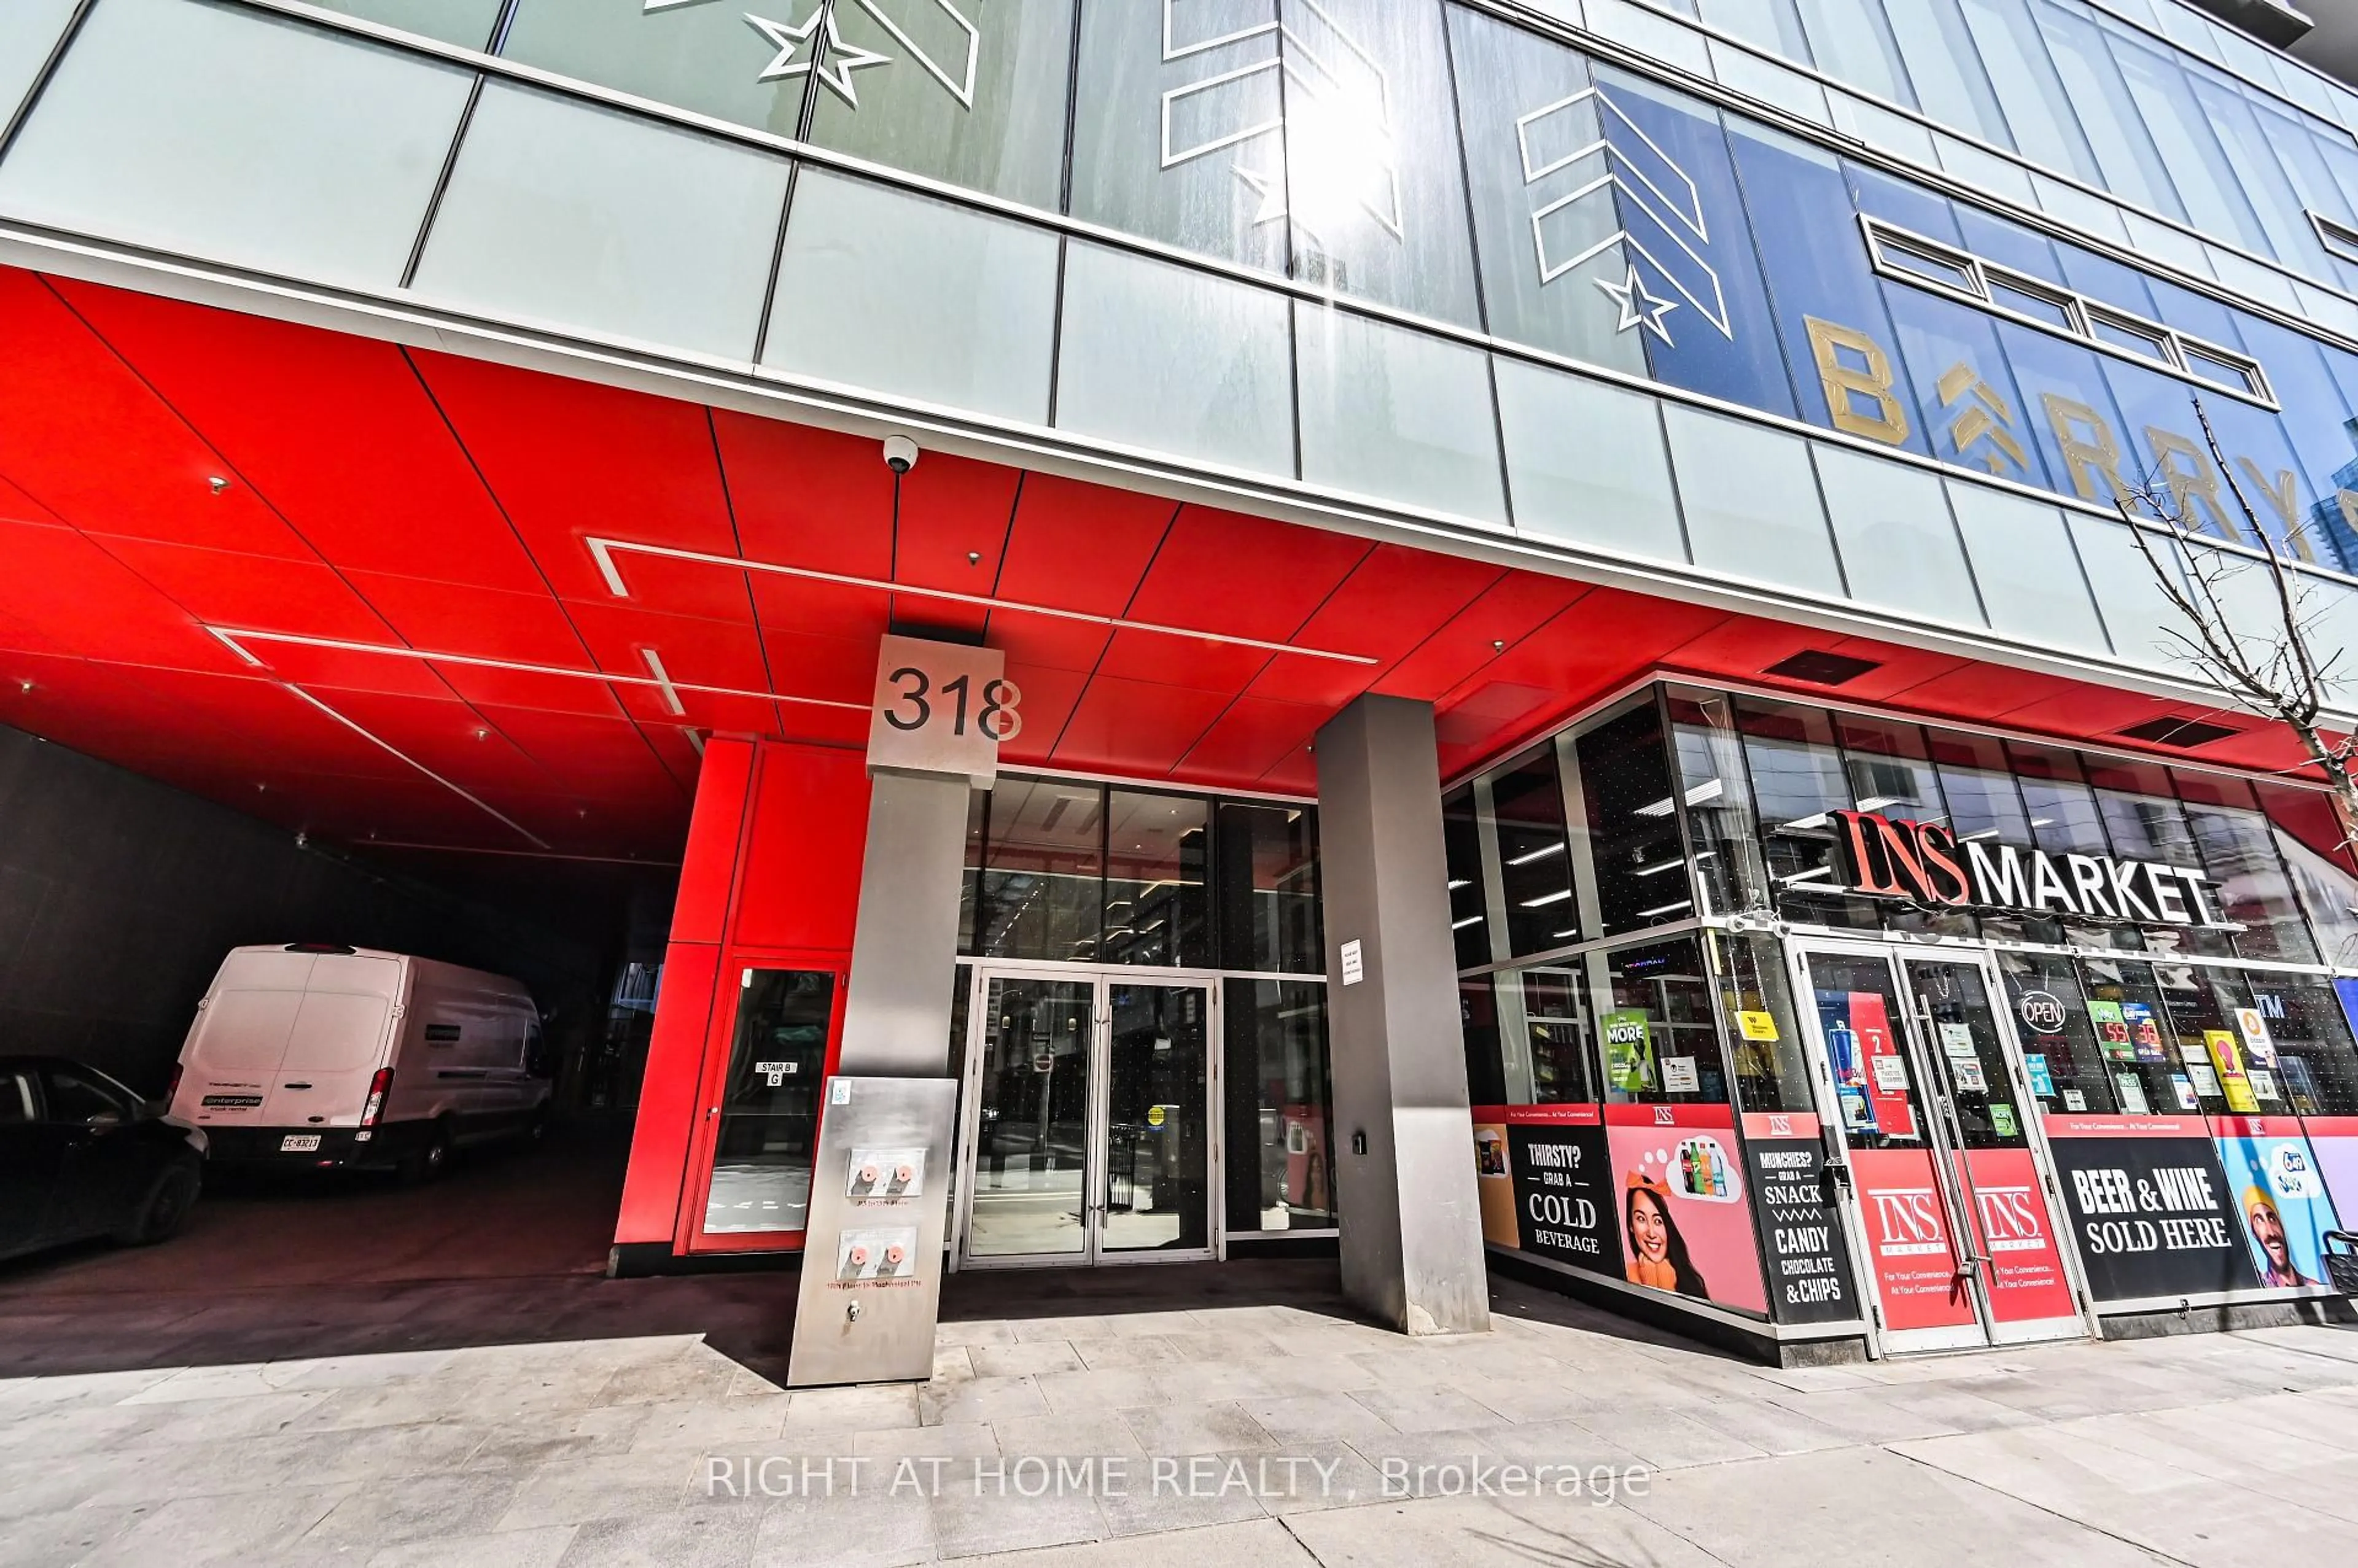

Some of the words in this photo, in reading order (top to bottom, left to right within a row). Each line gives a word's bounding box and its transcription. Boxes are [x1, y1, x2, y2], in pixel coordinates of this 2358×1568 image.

[884, 667, 1022, 741] 318
[1836, 809, 1969, 905] INS
[1967, 842, 2212, 925] MARKET
[2025, 1002, 2061, 1022] OPEN
[1606, 1026, 1644, 1044] MORE
[771, 1074, 779, 1084] G
[1652, 1106, 1675, 1124] INS
[1768, 1115, 1792, 1135] INS
[1528, 1143, 1581, 1168] THIRSTY?
[1759, 1151, 1812, 1169] MUNCHIES?
[1544, 1171, 1564, 1186] GRAB
[1566, 1173, 1572, 1187] A
[1778, 1171, 1794, 1181] GRAB
[1795, 1170, 1801, 1181] A
[1765, 1184, 1823, 1205] SNACK
[2071, 1168, 2138, 1214] BEER
[2137, 1178, 2163, 1212] &
[2152, 1167, 2219, 1211] WINE
[1529, 1193, 1597, 1229] COLD
[1872, 1193, 1944, 1243] INS
[1976, 1192, 2042, 1239] INS
[1535, 1228, 1600, 1254] BEVERAGE
[1775, 1227, 1829, 1254] CANDY
[1989, 1240, 2040, 1251] MARKET
[2087, 1221, 2158, 1254] SOLD
[2159, 1217, 2232, 1250] HERE
[1886, 1244, 1942, 1254] MARKET
[1781, 1257, 1835, 1275] CHOCOLATE
[1884, 1272, 1895, 1281] For
[1896, 1271, 1911, 1281] Your
[1891, 1286, 1899, 1295] At
[1899, 1286, 1913, 1294] Your
